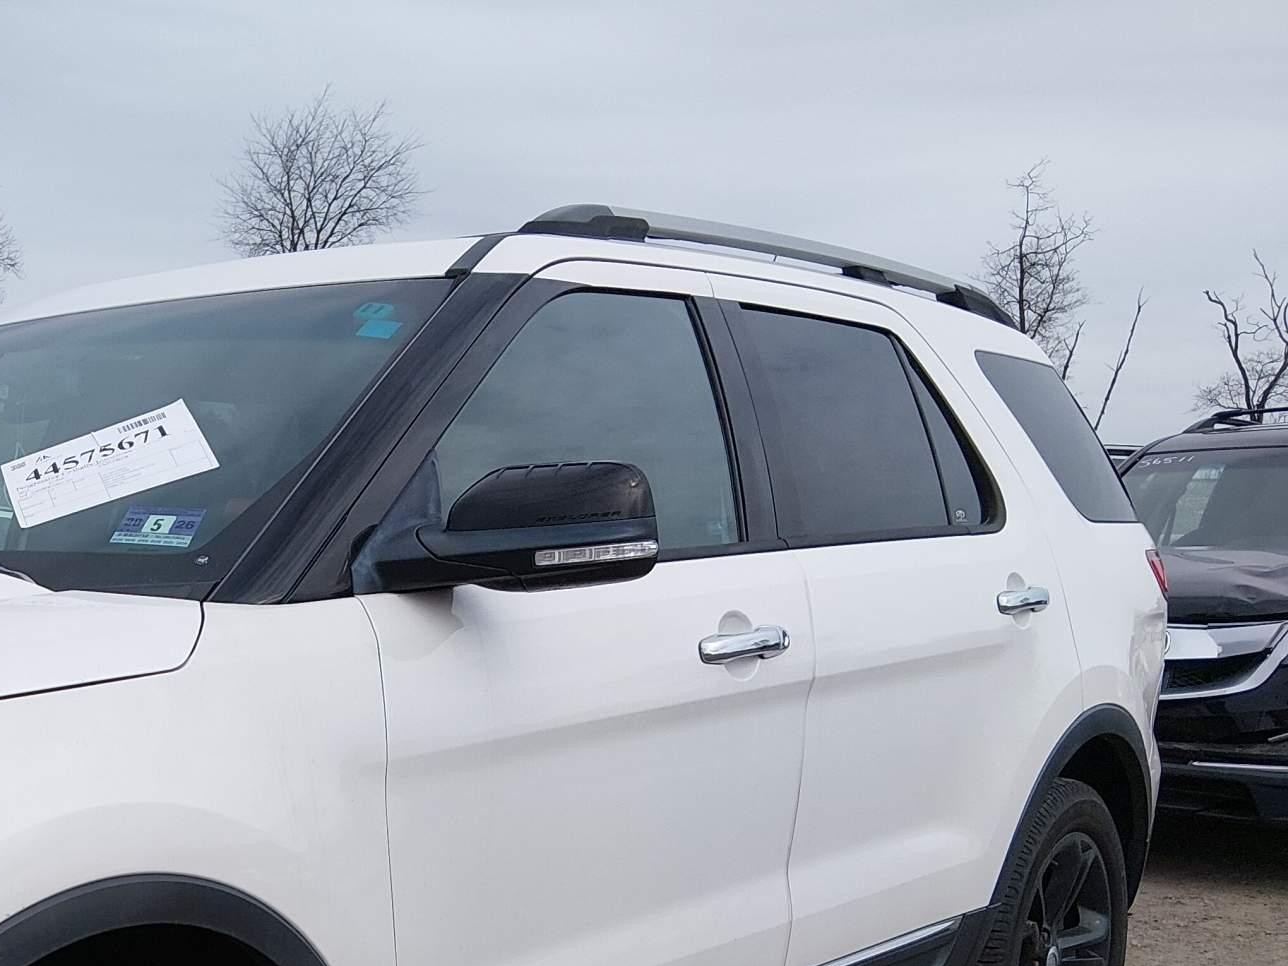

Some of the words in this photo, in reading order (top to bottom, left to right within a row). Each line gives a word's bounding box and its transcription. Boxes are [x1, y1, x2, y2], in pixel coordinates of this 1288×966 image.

[25, 424, 169, 482] 44575671
[124, 517, 143, 527] 20
[150, 518, 165, 532] 5
[175, 520, 196, 530] 26
